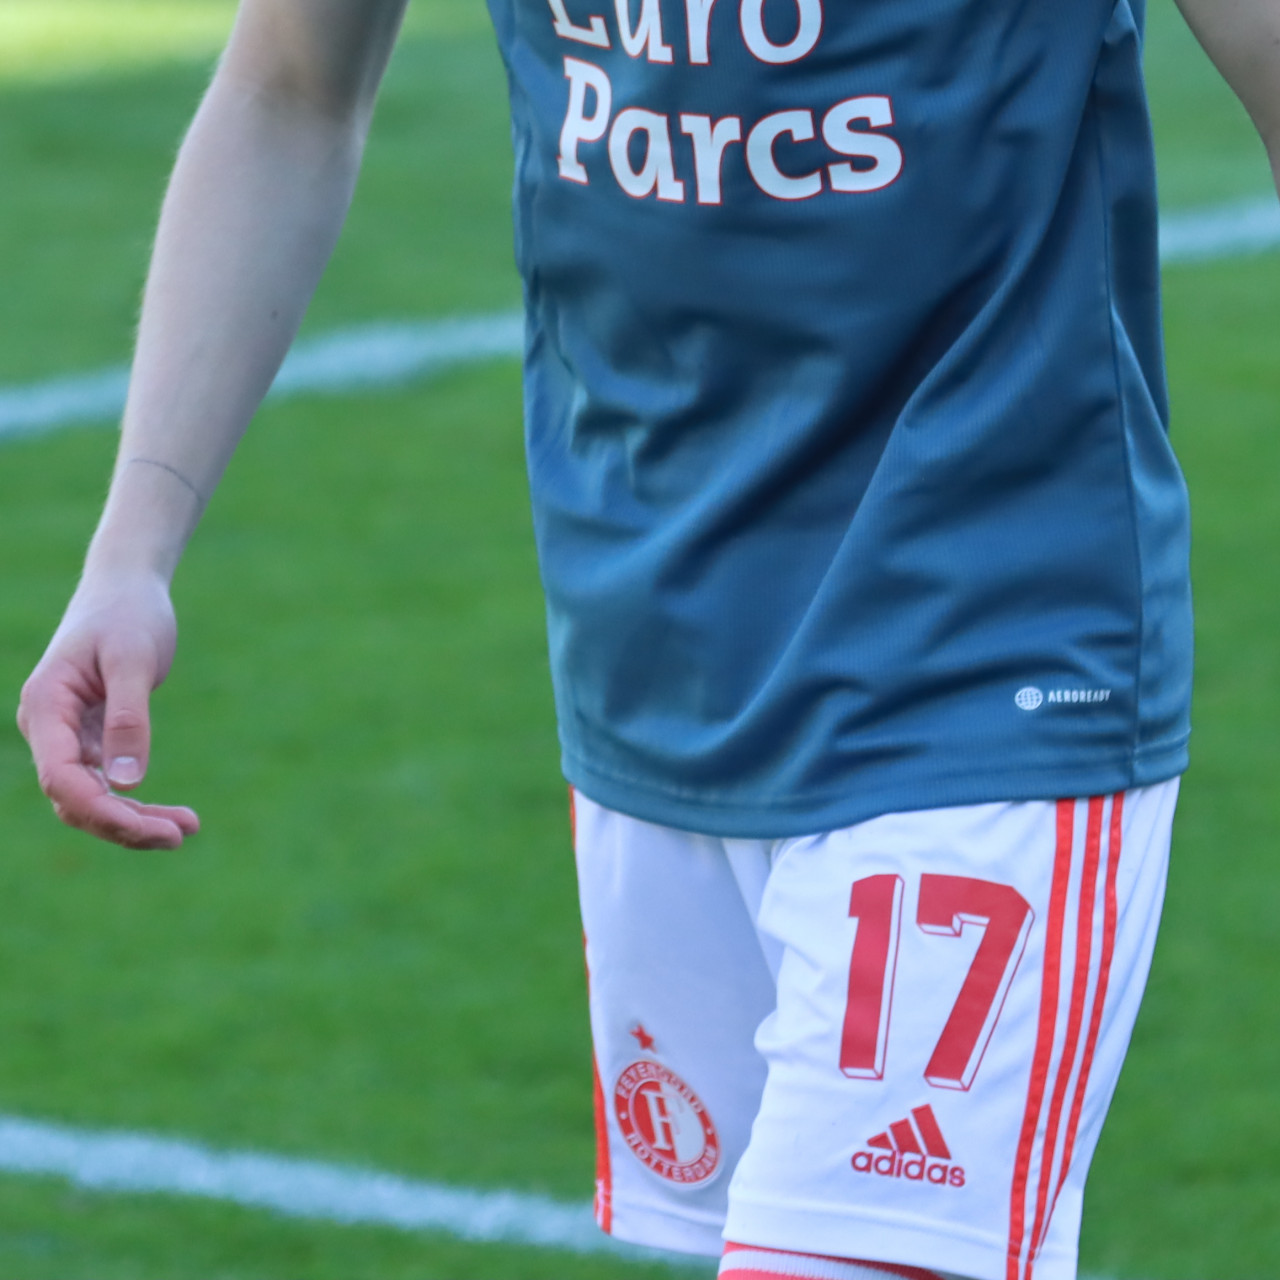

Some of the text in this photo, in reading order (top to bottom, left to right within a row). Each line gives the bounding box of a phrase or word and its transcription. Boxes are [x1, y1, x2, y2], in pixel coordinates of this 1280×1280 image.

[556, 55, 905, 206] Parcs
[838, 871, 1037, 1093] 17
[850, 1149, 966, 1188] adidas
